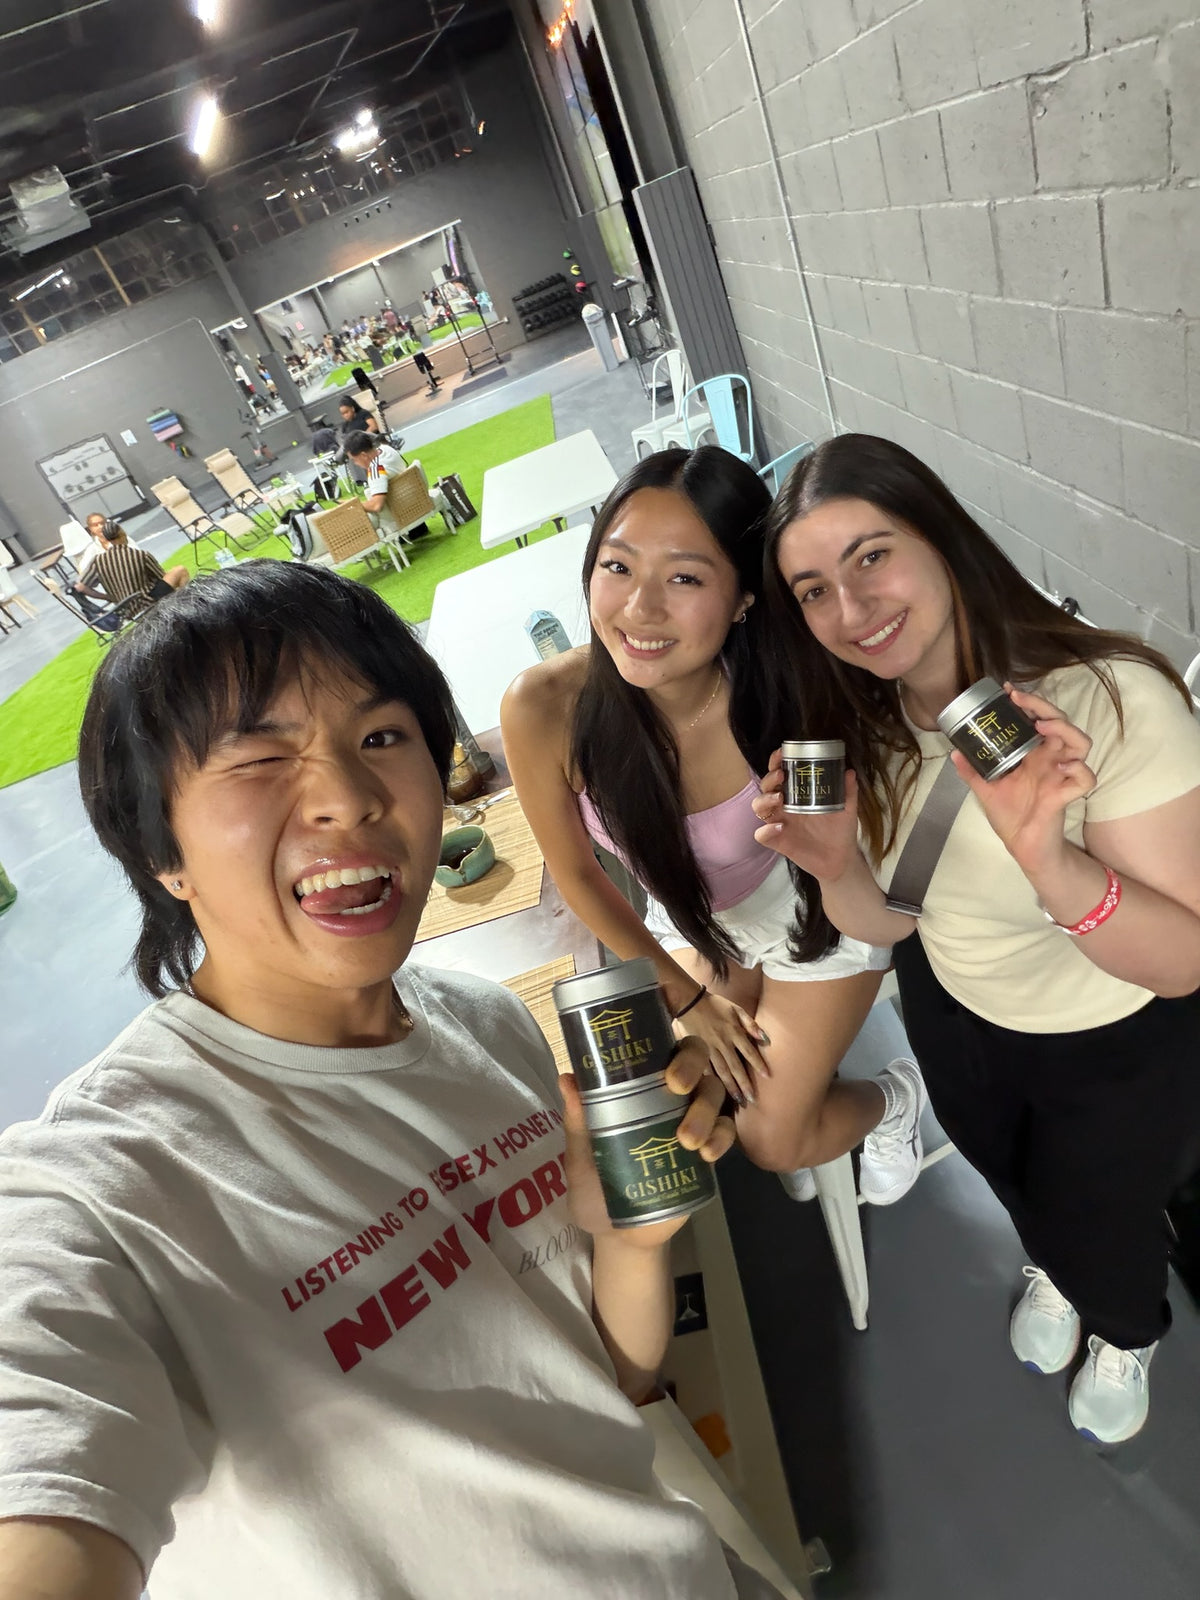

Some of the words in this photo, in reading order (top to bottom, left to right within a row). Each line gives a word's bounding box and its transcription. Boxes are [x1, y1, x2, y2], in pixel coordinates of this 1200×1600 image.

[582, 1037, 653, 1069] GSHIKI
[281, 1211, 404, 1313] LISTENING
[396, 1187, 430, 1219] TO
[493, 1109, 555, 1159] HONEY
[625, 1166, 697, 1200] GISHIKI
[323, 1224, 473, 1374] NEW
[462, 1152, 568, 1244] YOR
